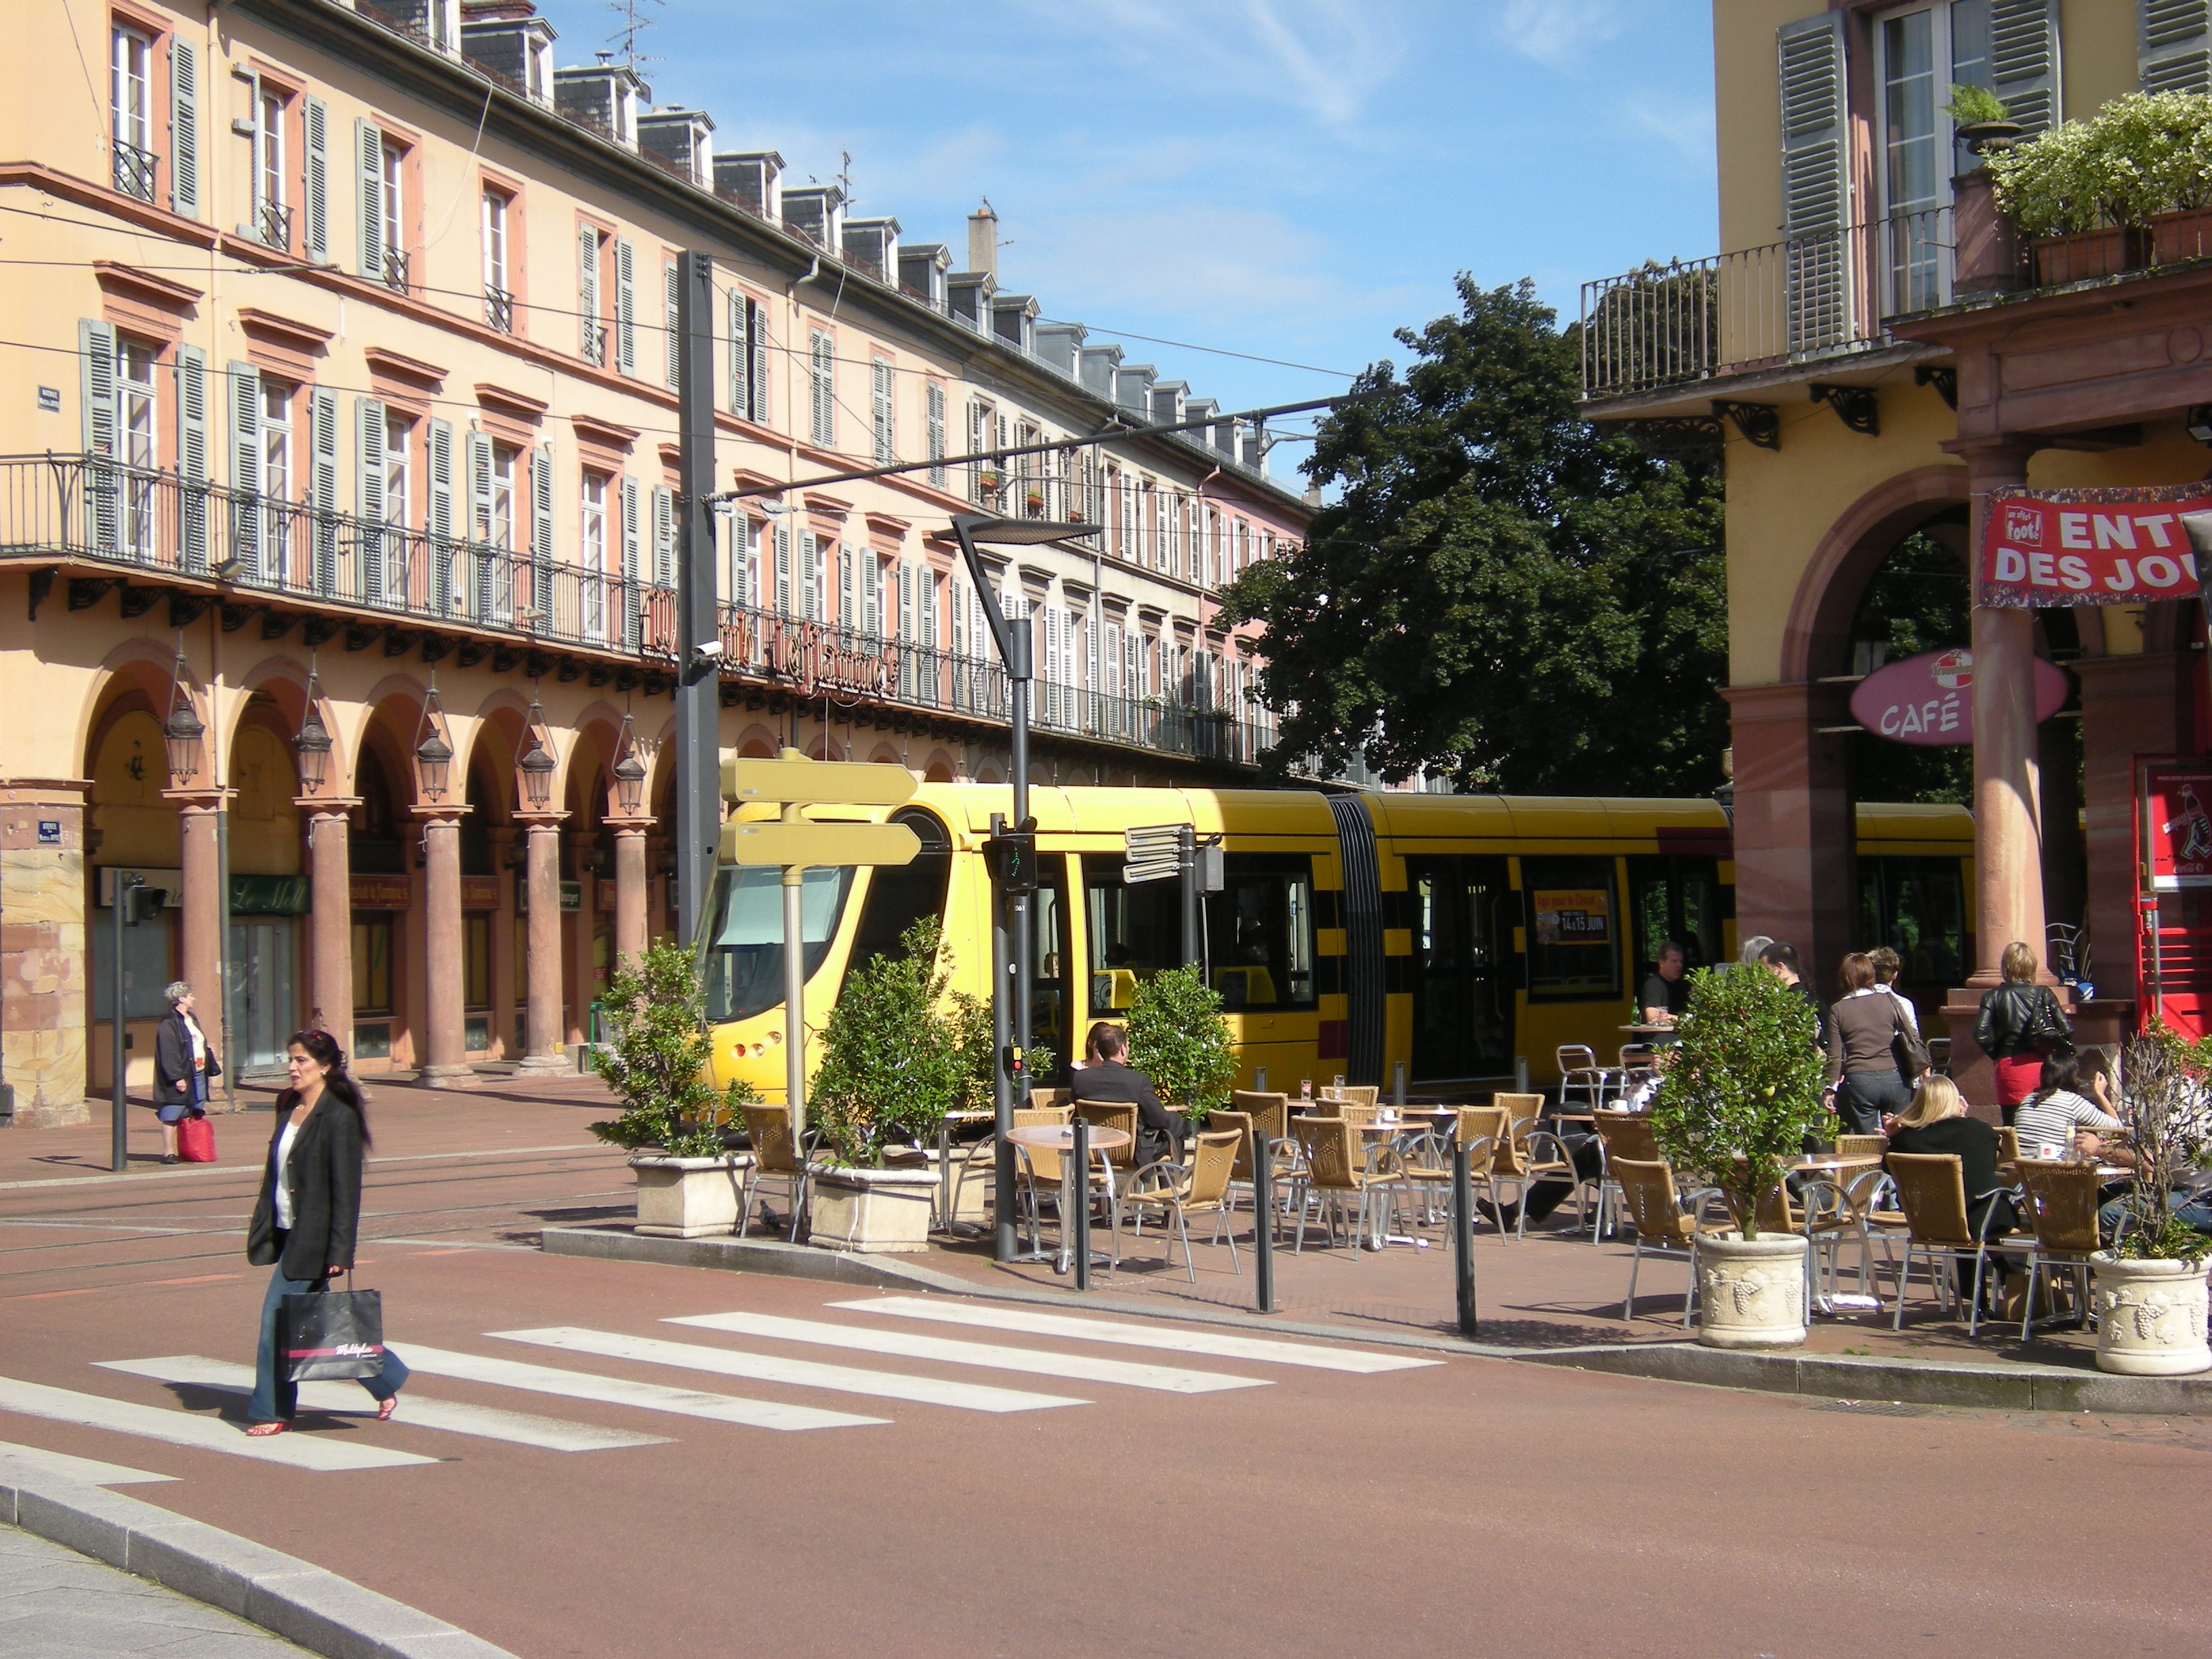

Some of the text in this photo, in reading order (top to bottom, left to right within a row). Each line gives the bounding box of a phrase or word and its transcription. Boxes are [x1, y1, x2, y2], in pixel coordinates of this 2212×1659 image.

[2060, 508, 2212, 550] ENT
[1994, 548, 2092, 590] DES
[1880, 691, 1961, 738] CAFÉ
[1586, 916, 1604, 930] JUIN
